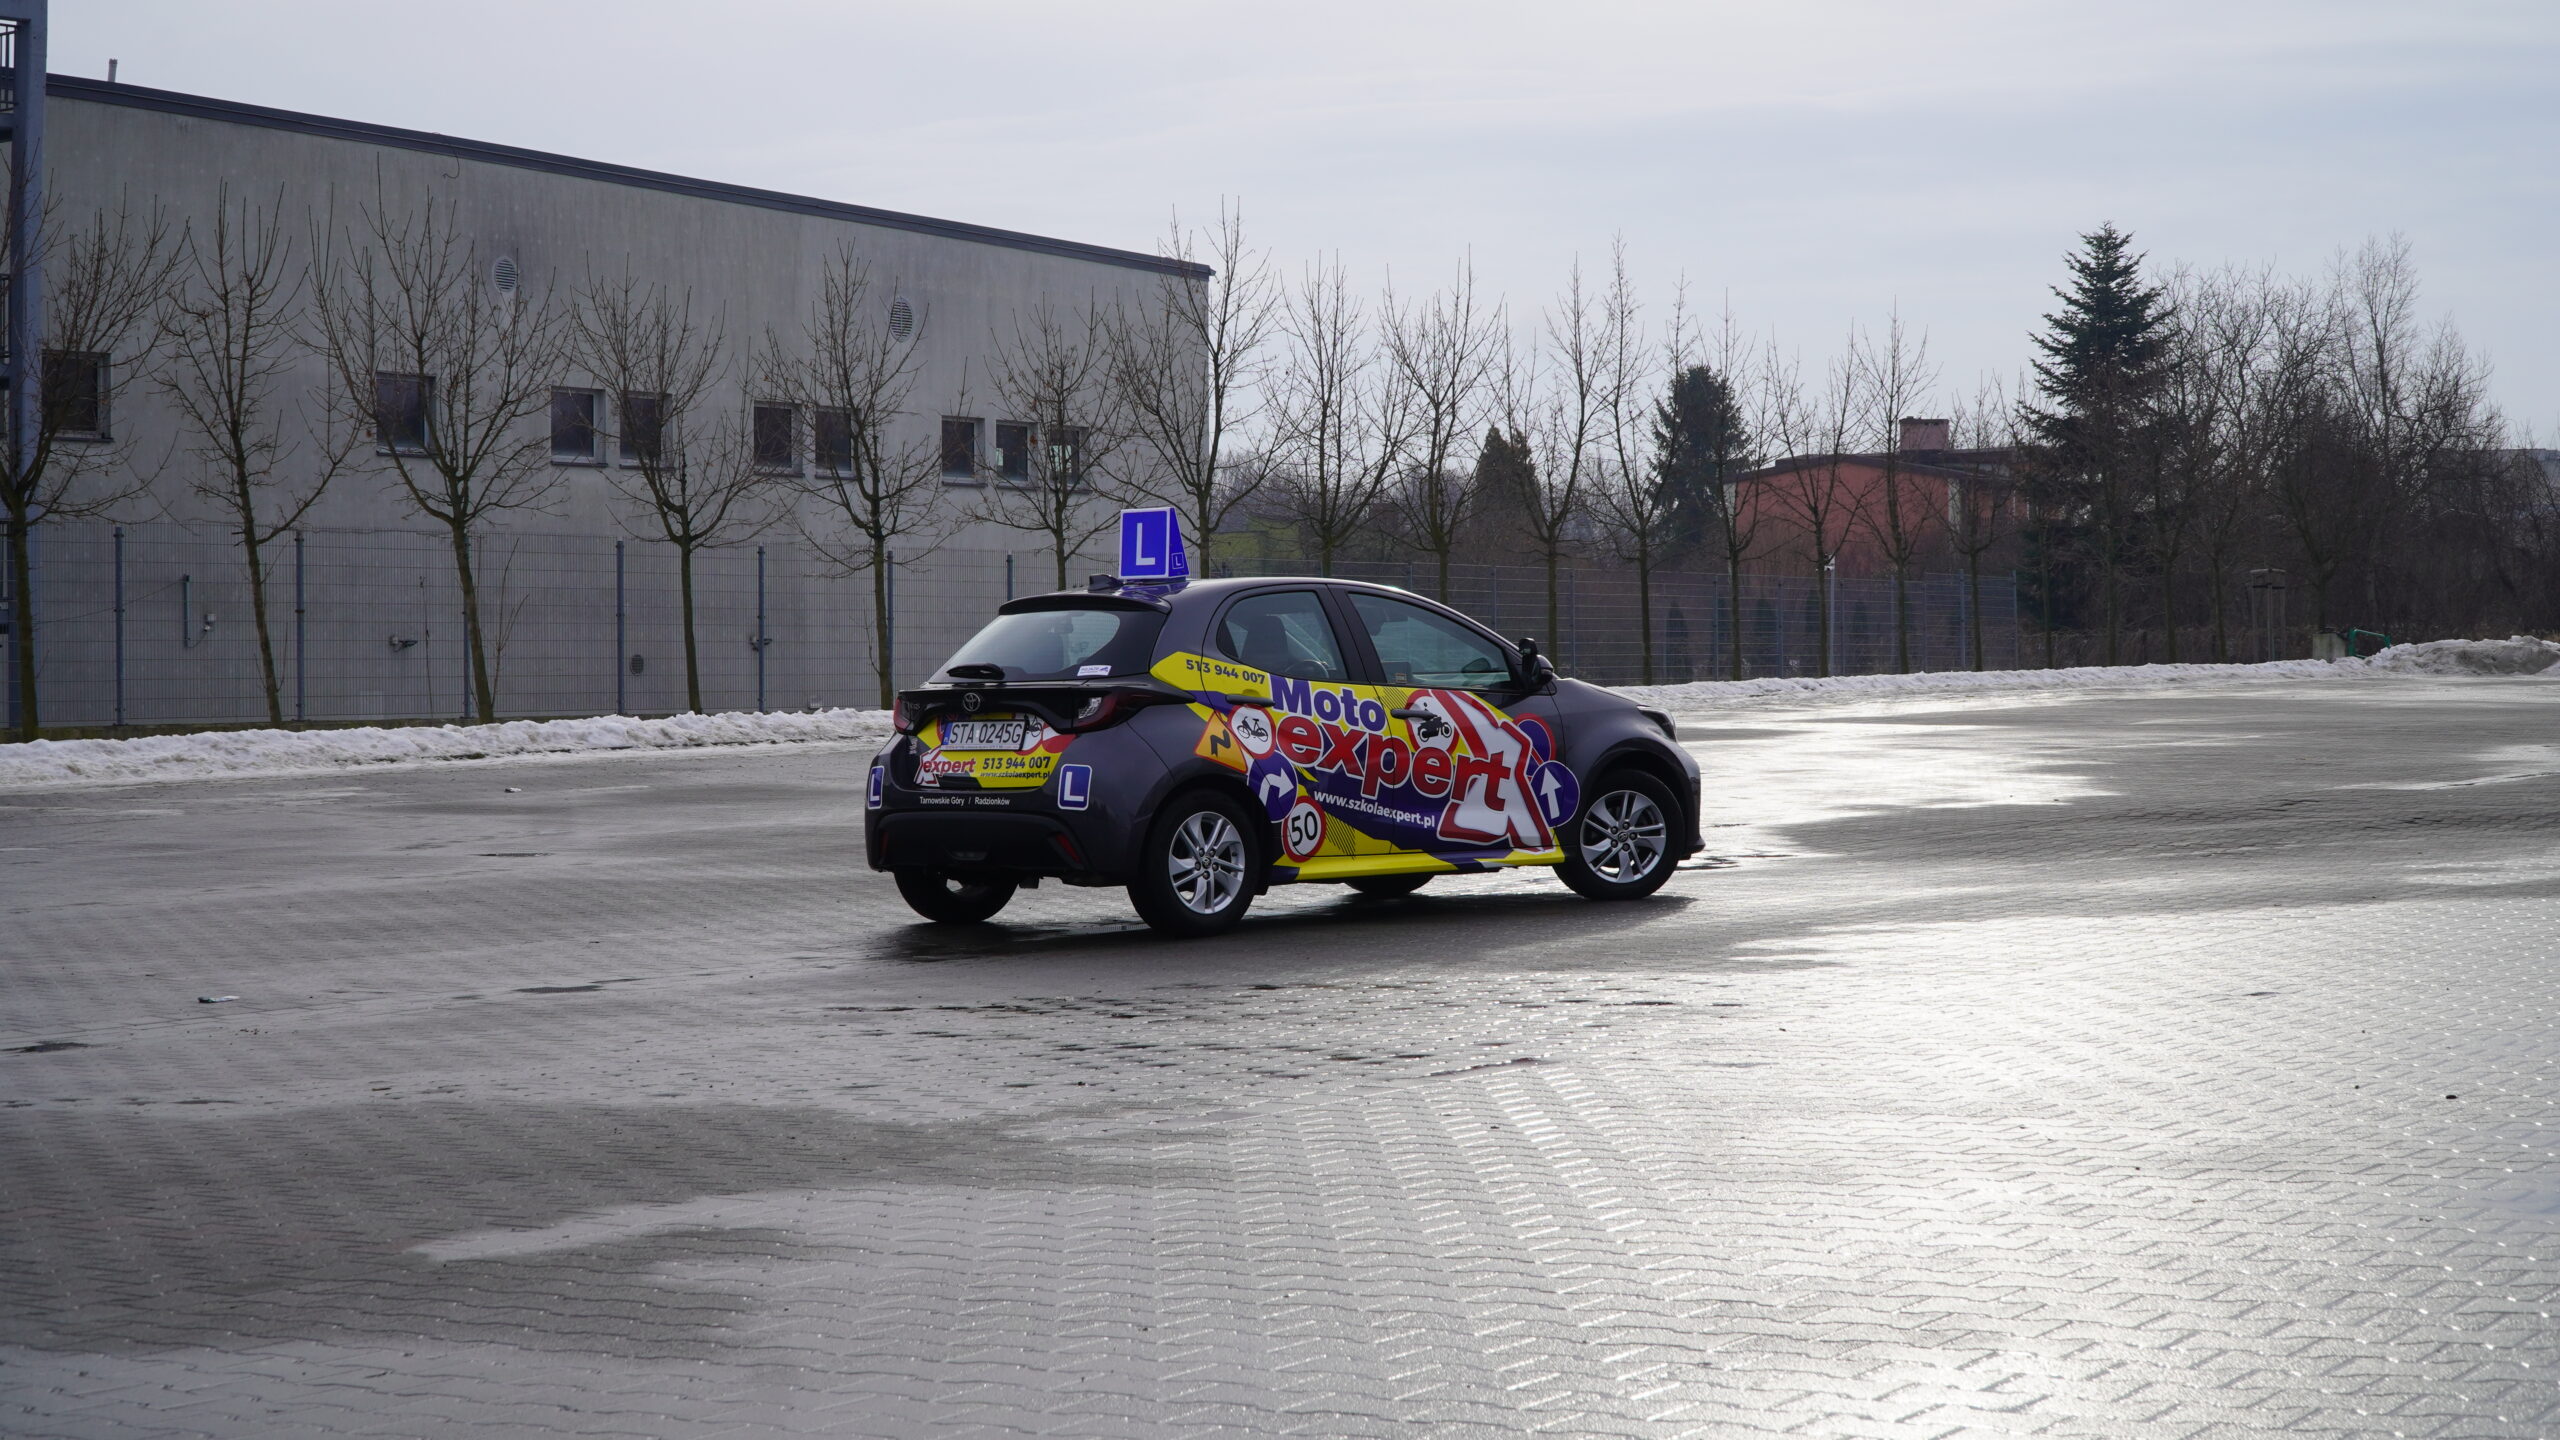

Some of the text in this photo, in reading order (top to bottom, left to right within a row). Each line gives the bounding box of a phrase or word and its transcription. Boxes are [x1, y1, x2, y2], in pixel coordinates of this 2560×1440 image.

[1136, 523, 1155, 566] L
[1175, 556, 1182, 566] L
[1186, 659, 1266, 684] 513 944 007
[1270, 674, 1386, 732] Moto
[950, 723, 1023, 744] STA 0245G
[923, 757, 976, 775] expert
[982, 756, 1051, 769] 513 944 007
[1277, 715, 1511, 812] expert
[870, 773, 880, 801] L
[1063, 771, 1085, 802] L
[920, 796, 950, 804] Tarnowskie
[951, 796, 965, 806] Góry
[975, 796, 1010, 805] Radzionków
[1313, 790, 1435, 829] www.szkolaexpert.pl
[1291, 811, 1318, 847] 50
